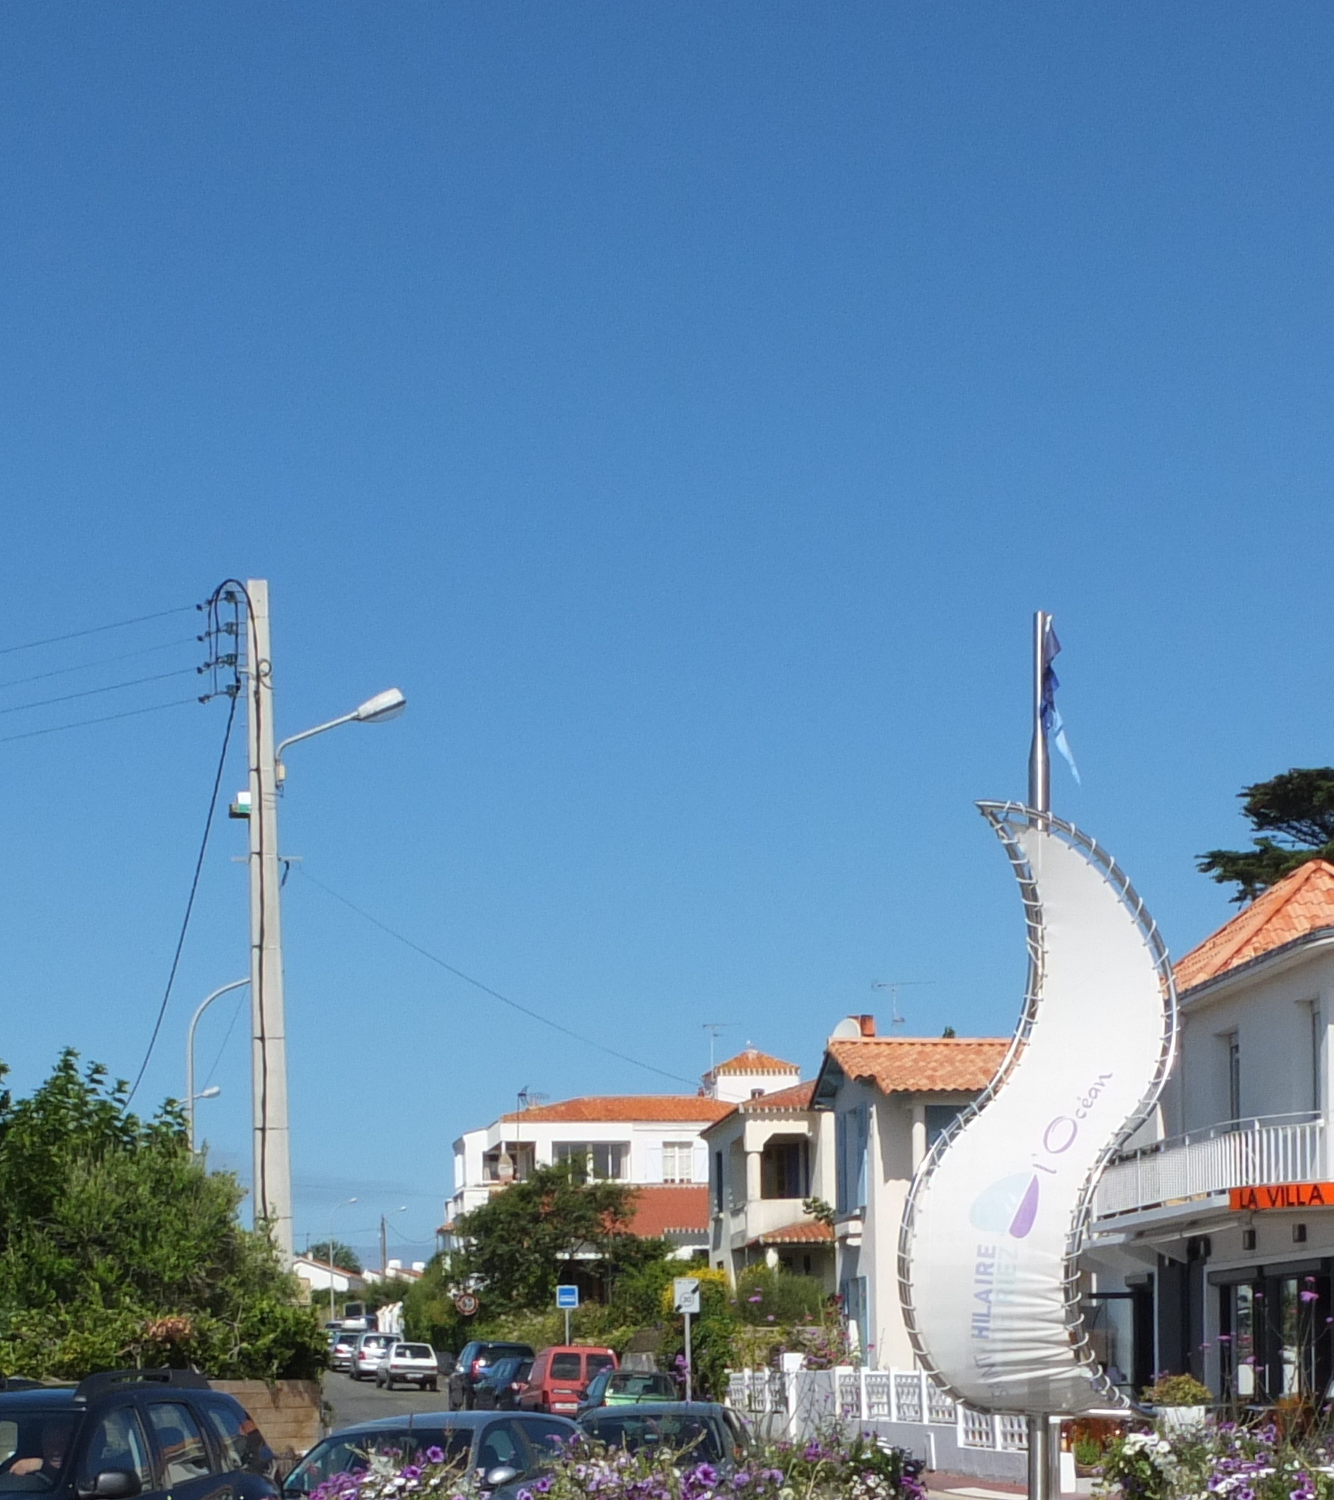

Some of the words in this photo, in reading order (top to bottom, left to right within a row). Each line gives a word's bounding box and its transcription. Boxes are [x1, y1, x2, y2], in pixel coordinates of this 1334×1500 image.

[1239, 1188, 1259, 1209] LA
[1266, 1184, 1325, 1208] VILLA
[970, 1244, 997, 1340] HILAIRE
